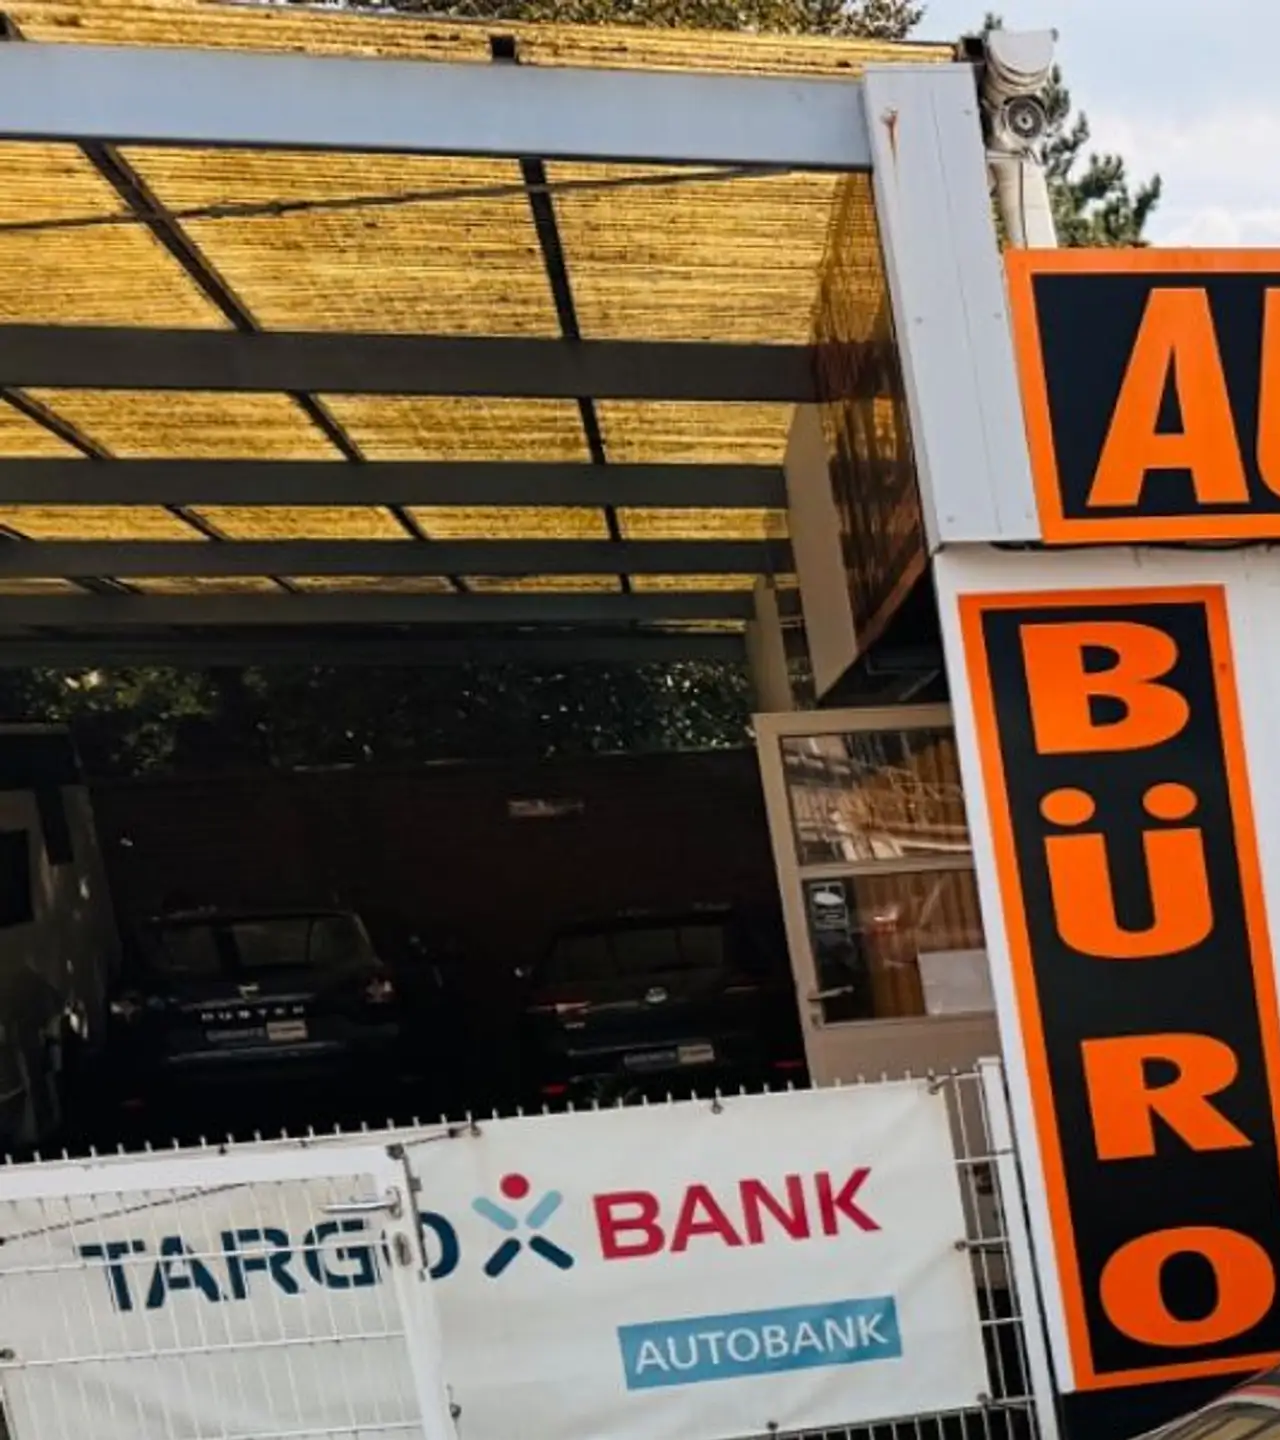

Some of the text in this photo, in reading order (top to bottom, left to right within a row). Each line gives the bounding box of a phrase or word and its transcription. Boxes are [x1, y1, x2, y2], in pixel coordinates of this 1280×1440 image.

[1018, 620, 1276, 1347] BÜRO
[80, 1166, 883, 1312] TARGO BANK
[635, 1312, 888, 1376] AUTOBANK
